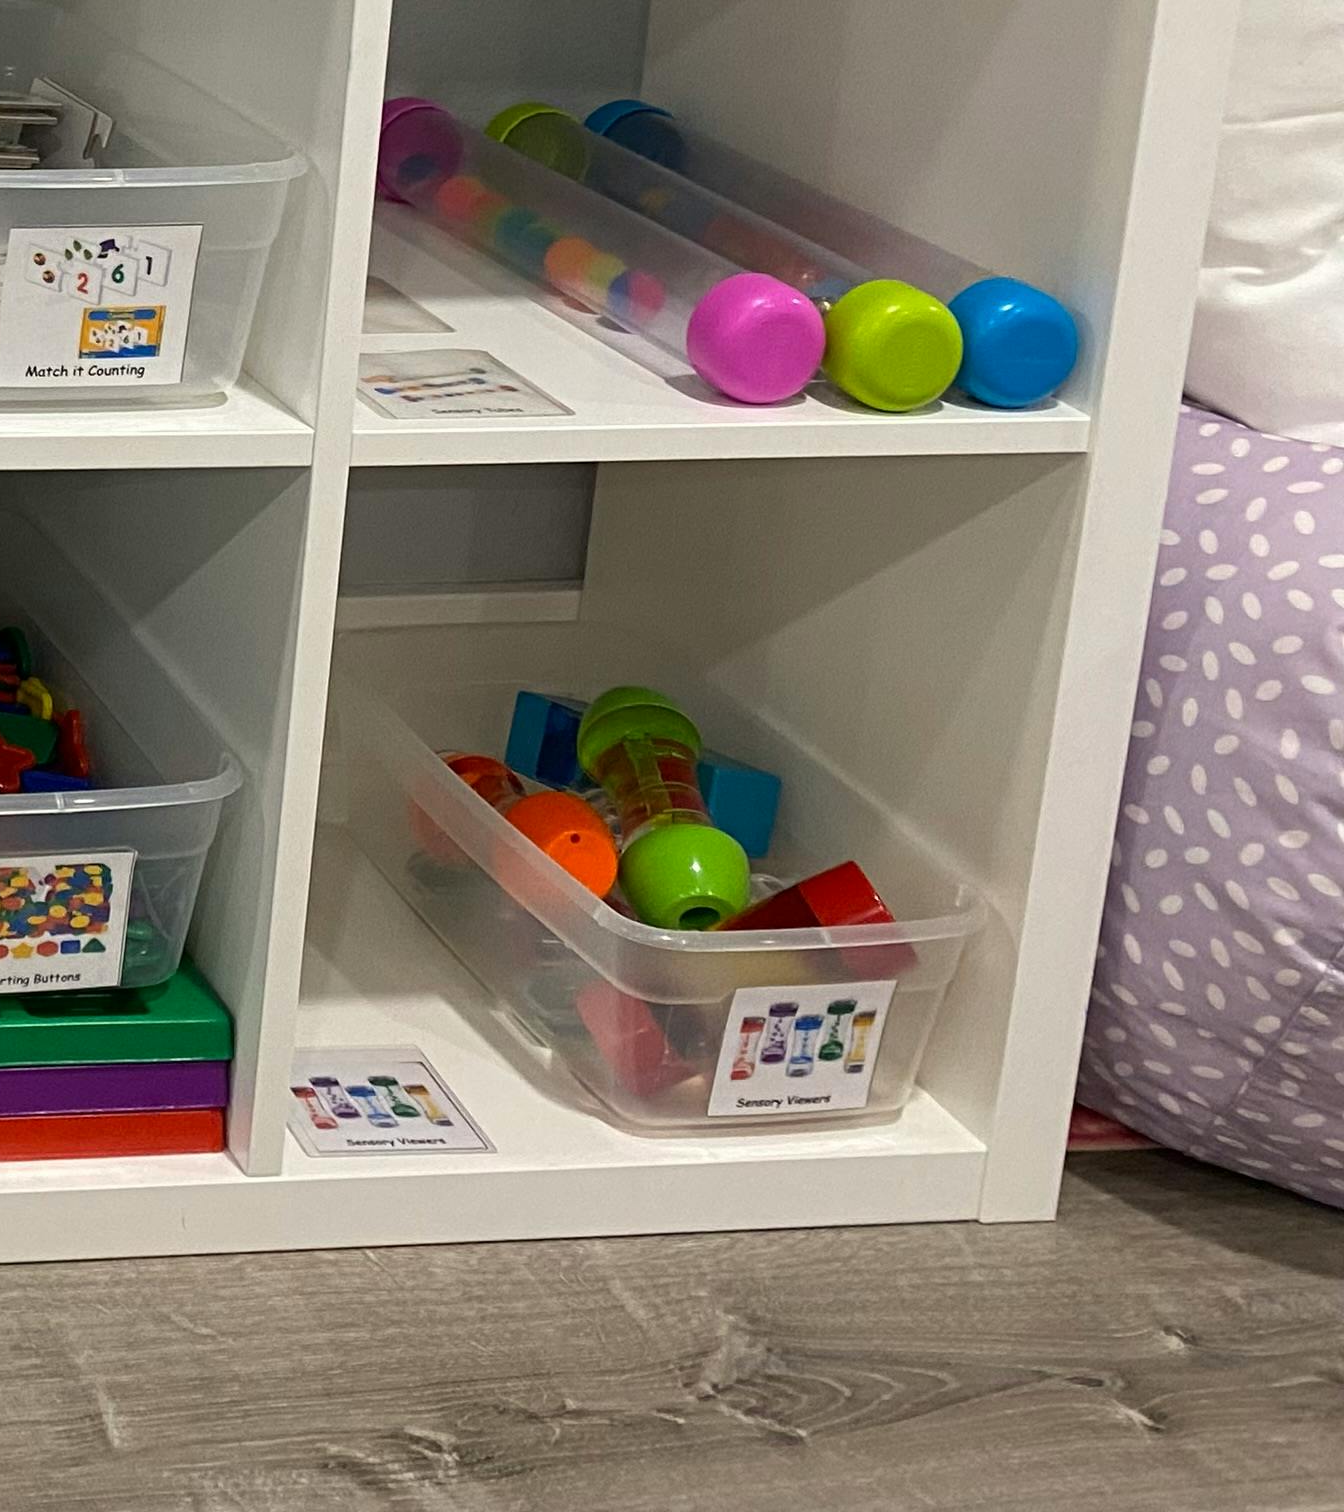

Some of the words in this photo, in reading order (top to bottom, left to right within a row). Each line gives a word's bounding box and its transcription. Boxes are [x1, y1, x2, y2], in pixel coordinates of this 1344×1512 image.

[111, 263, 125, 284] 6
[76, 272, 89, 295] 2
[25, 365, 68, 378] Match
[73, 366, 84, 377] it
[88, 364, 145, 378] Counting
[33, 973, 81, 985] Buttons
[736, 1097, 783, 1109] Sensory
[787, 1095, 831, 1105] Viewers
